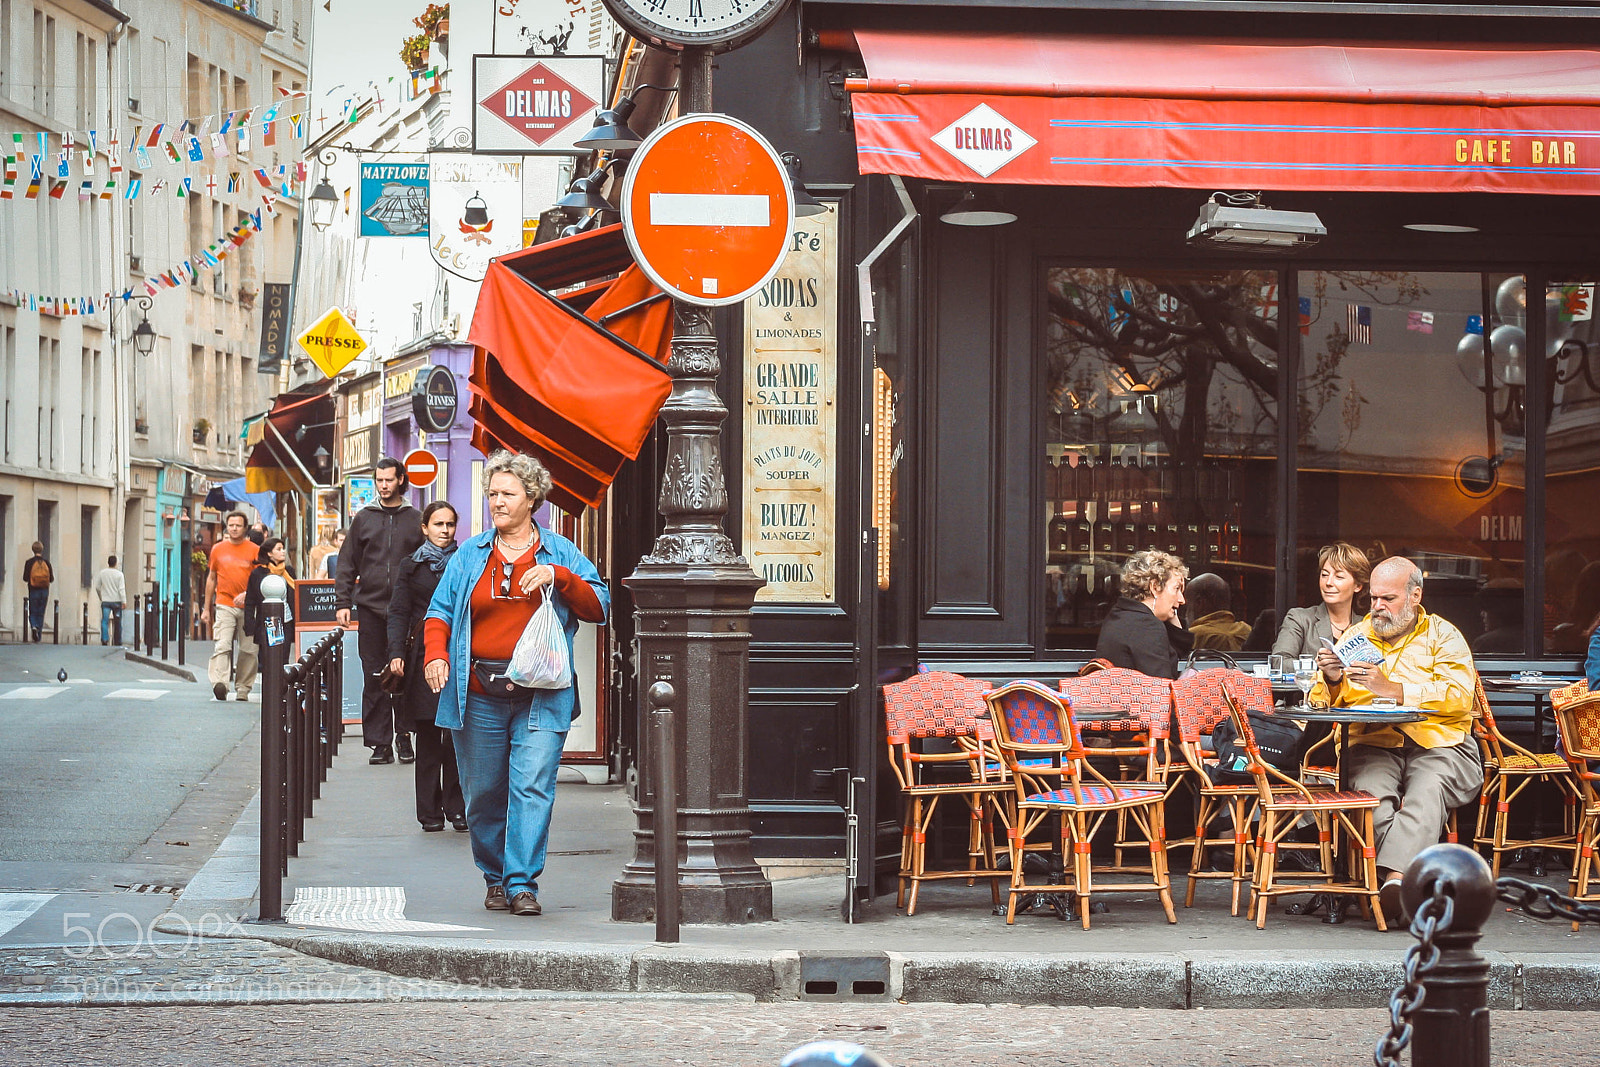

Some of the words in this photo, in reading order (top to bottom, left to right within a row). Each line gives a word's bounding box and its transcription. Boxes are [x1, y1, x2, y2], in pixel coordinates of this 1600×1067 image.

[505, 90, 571, 118] DELMAS
[955, 127, 1013, 151] DELMAS
[1455, 139, 1511, 163] CAFE
[1531, 140, 1576, 164] BAR
[788, 231, 820, 251] Fé
[758, 277, 818, 308] SODAS
[267, 285, 282, 354] NOMADS
[783, 312, 793, 322] &
[306, 335, 361, 350] PRESSE
[756, 328, 822, 338] LIMONADES
[756, 363, 819, 388] GRANDE
[427, 393, 456, 406] GUINNESS
[756, 390, 818, 405] SALLE
[757, 409, 819, 425] INTERIEURE
[754, 446, 782, 468] PLATS
[784, 446, 796, 458] DU
[798, 448, 822, 469] JOUR
[766, 471, 810, 480] SOUPER
[762, 563, 814, 583] ALCOOLS
[1339, 635, 1365, 657] PARIS
